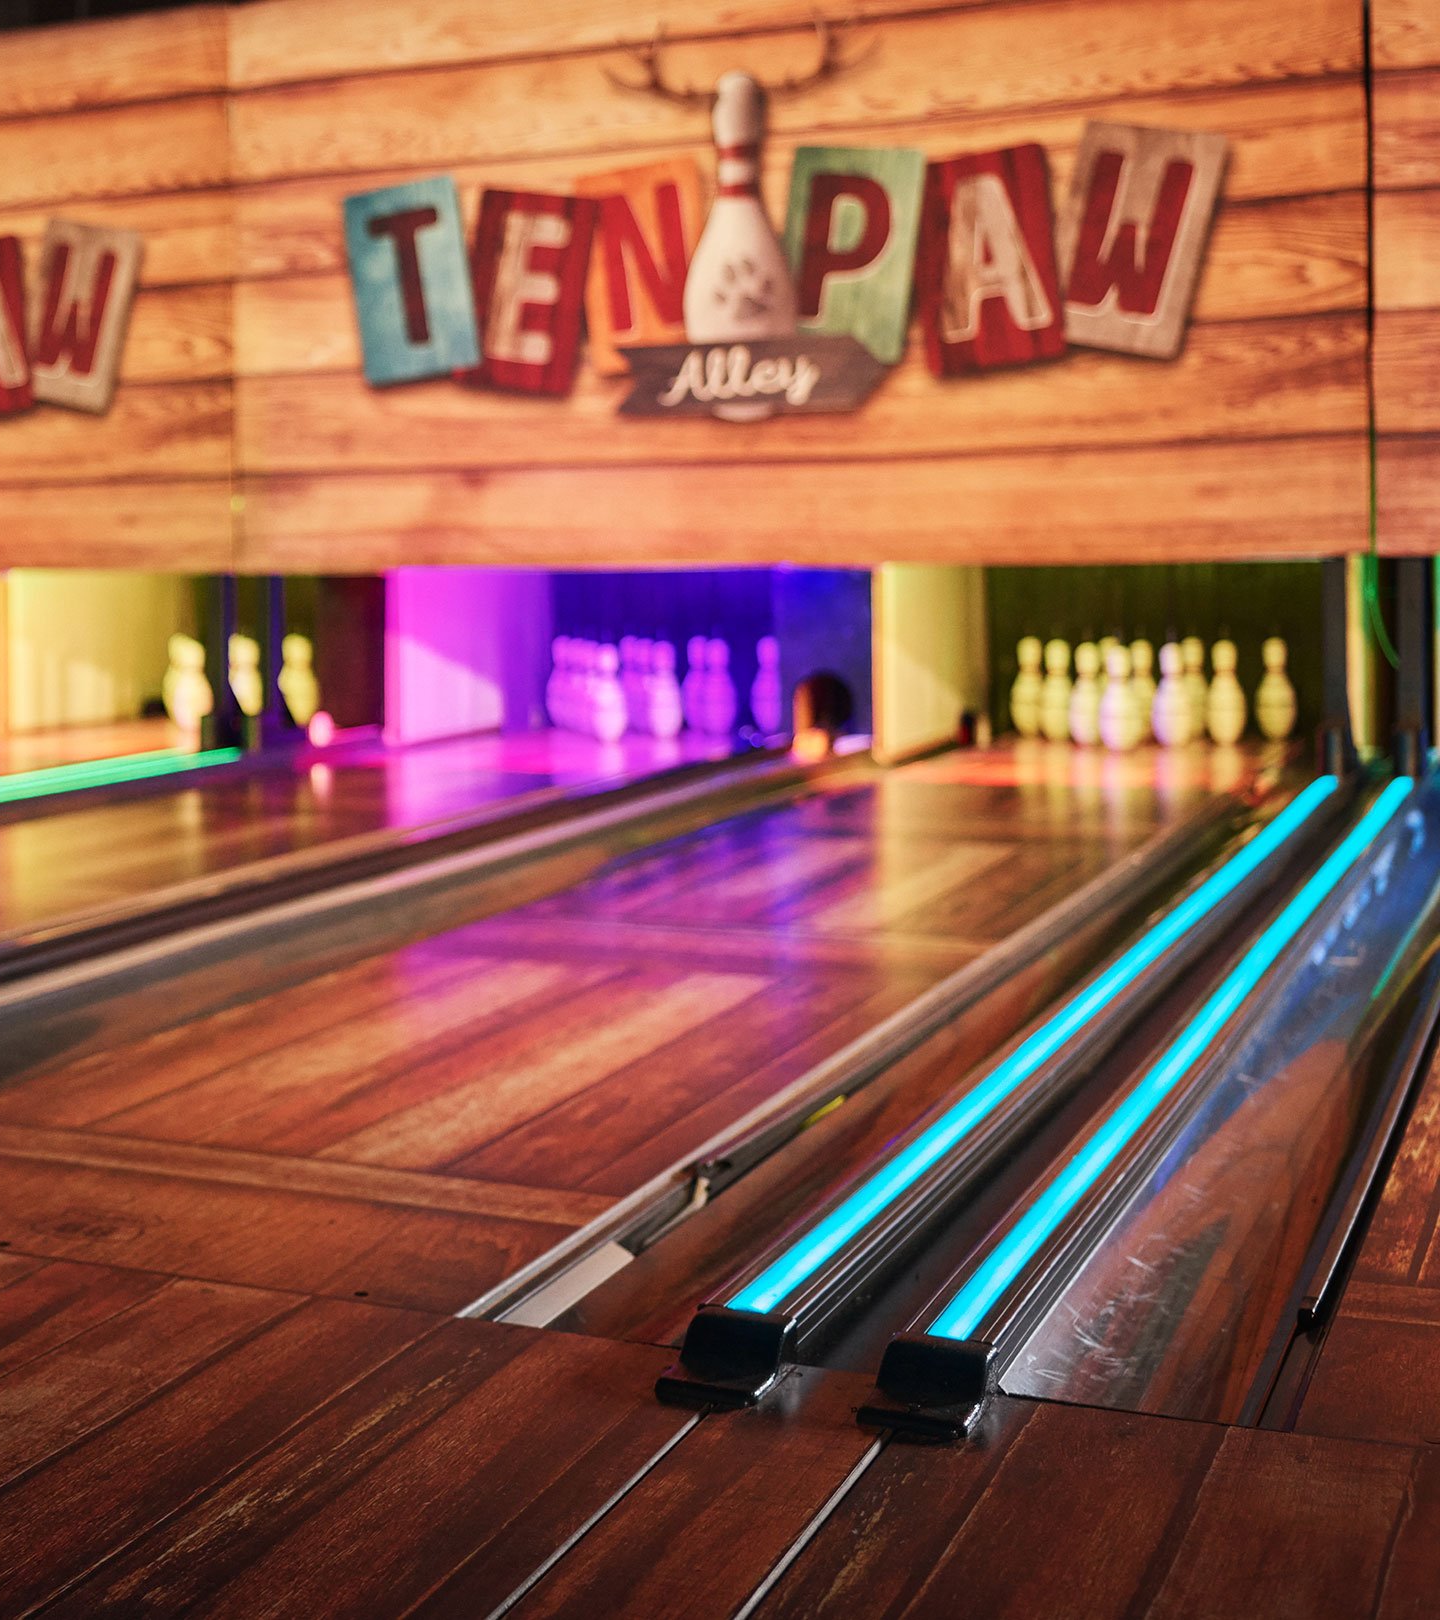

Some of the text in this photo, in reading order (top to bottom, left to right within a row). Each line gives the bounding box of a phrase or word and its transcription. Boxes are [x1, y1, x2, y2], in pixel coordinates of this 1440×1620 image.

[366, 152, 1195, 367] TEN PAW
[658, 346, 821, 408] Alley
